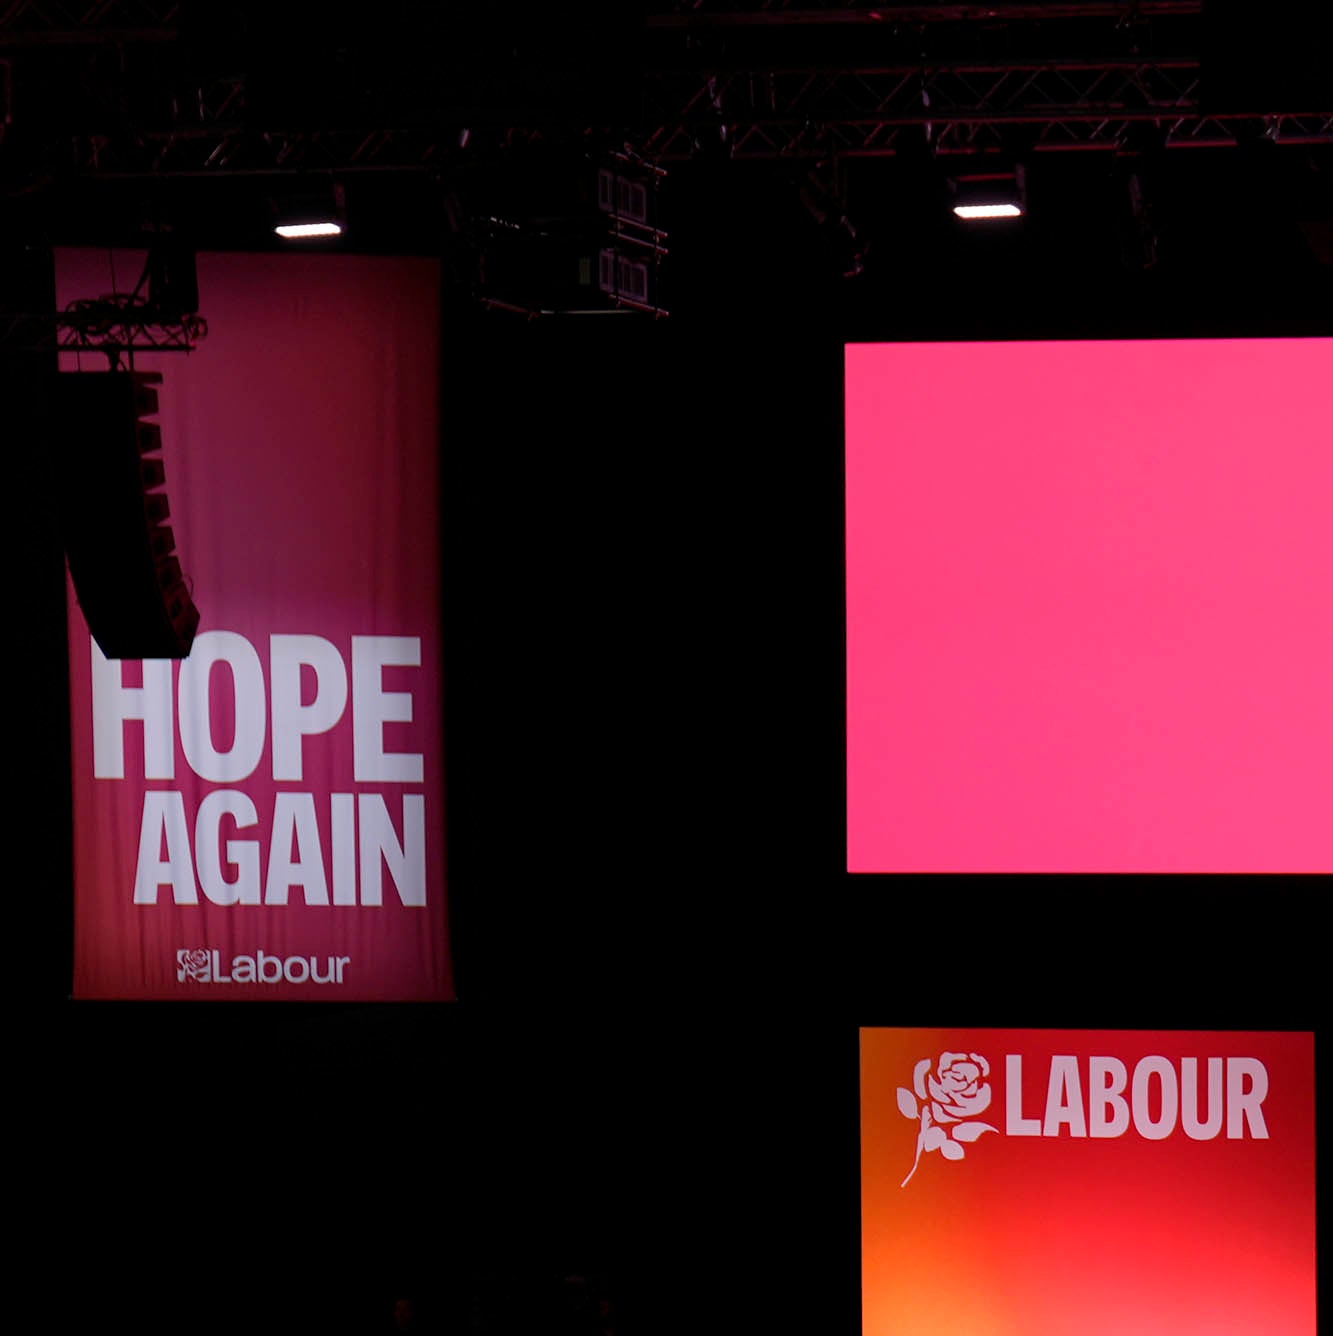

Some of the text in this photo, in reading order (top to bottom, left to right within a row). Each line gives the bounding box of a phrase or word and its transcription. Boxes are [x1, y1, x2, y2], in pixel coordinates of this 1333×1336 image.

[90, 630, 425, 784] HOPE
[133, 789, 427, 907] AGAIN
[212, 949, 351, 984] Labour
[1005, 1053, 1270, 1141] LABOUR
